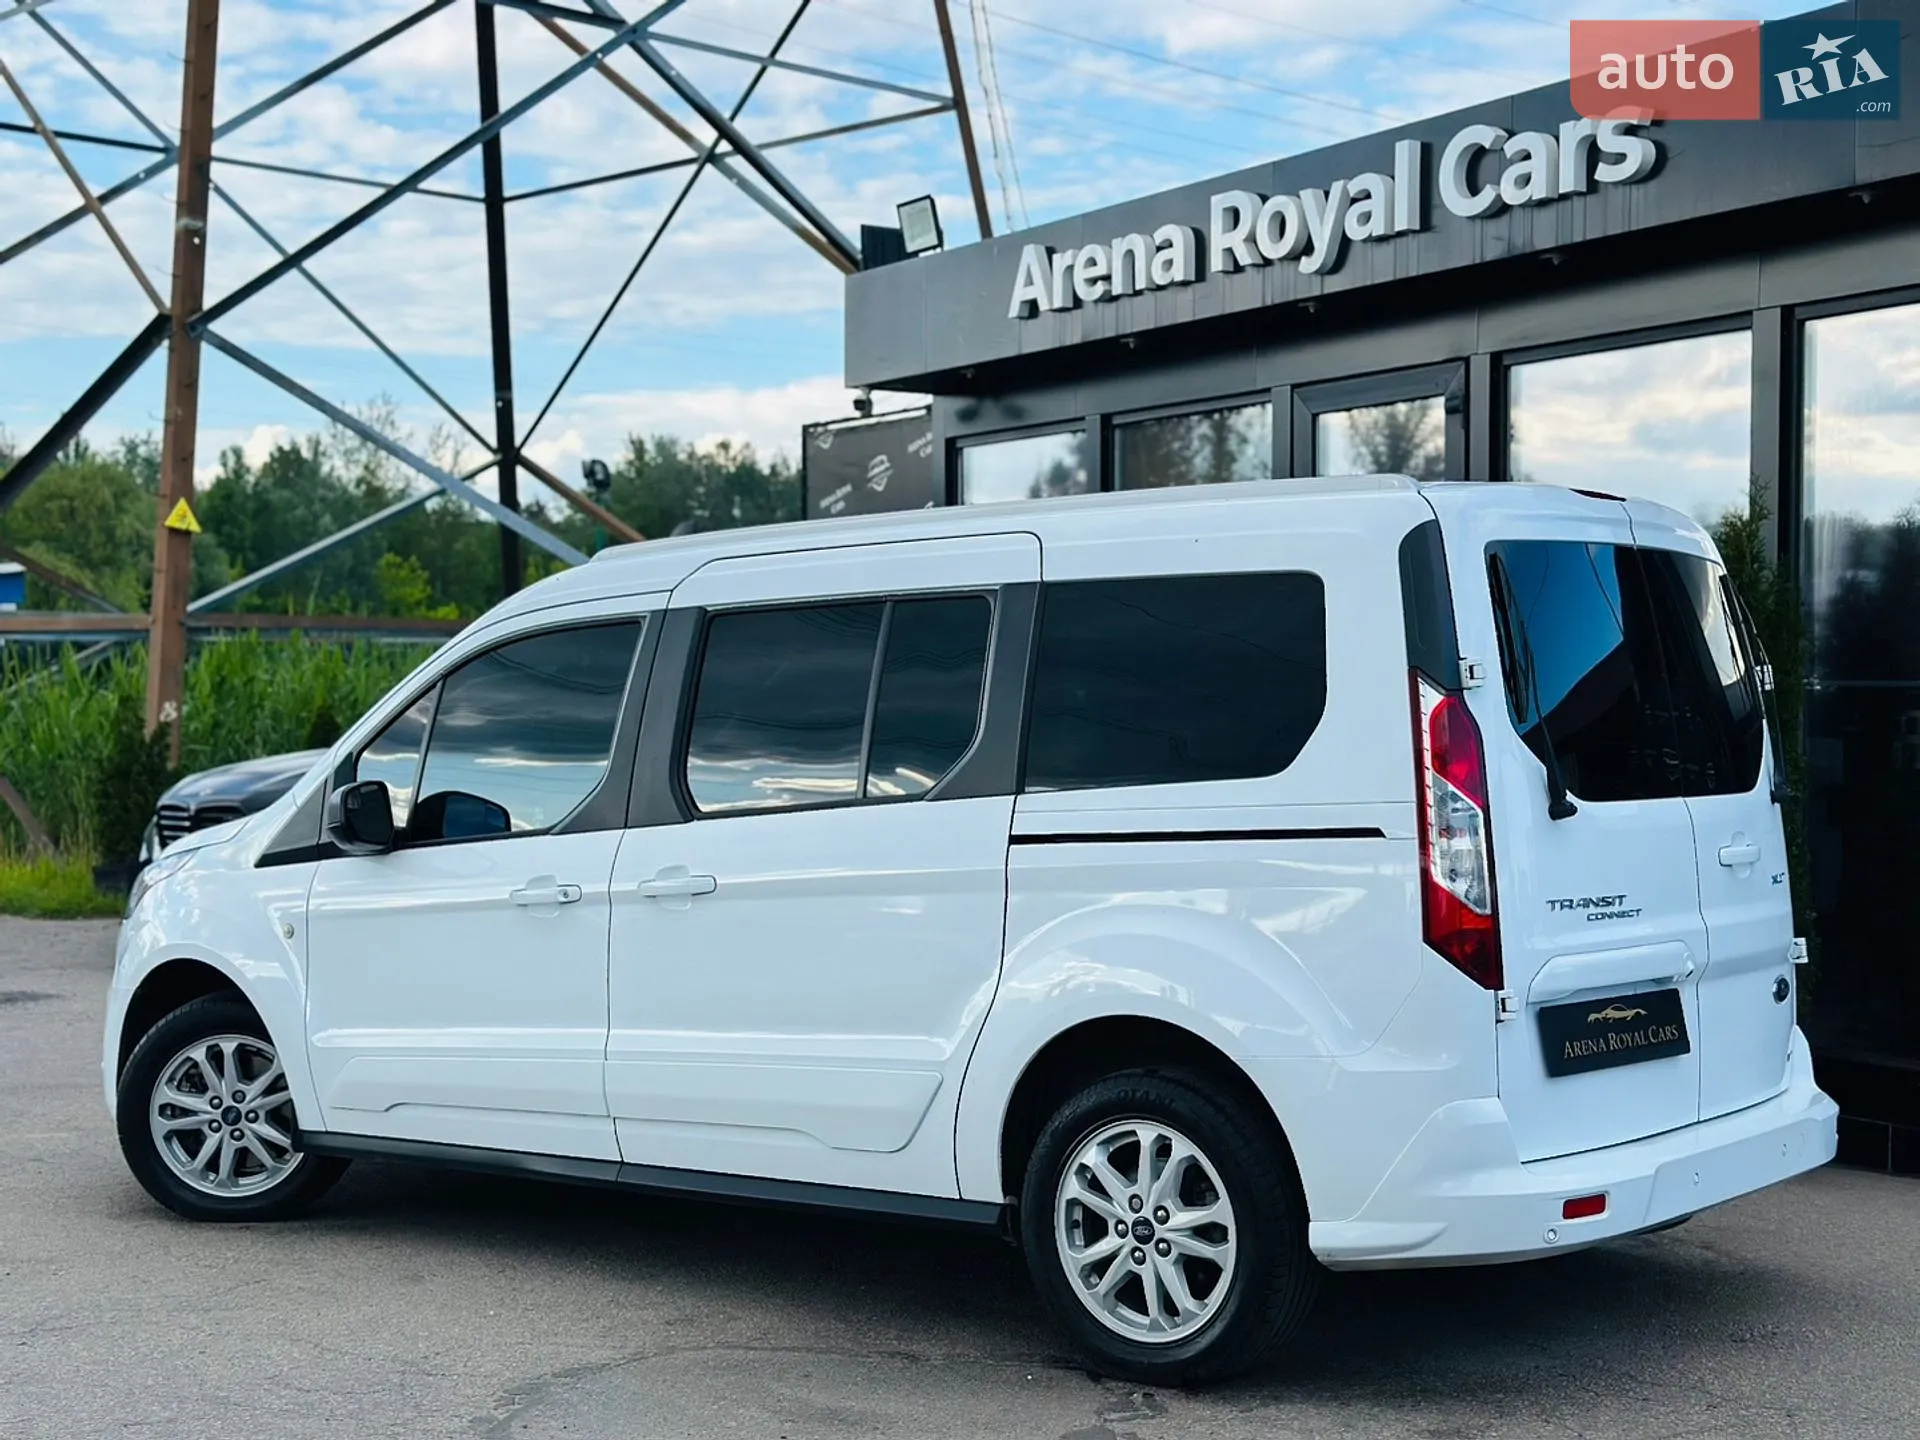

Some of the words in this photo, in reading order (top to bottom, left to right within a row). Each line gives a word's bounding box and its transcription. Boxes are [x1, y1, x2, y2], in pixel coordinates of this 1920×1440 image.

[1008, 223, 1200, 319] Arena
[1210, 138, 1425, 276] Royal
[1438, 105, 1657, 219] Cars
[1546, 894, 1627, 911] TRANSIT
[1587, 908, 1642, 921] CONNECT
